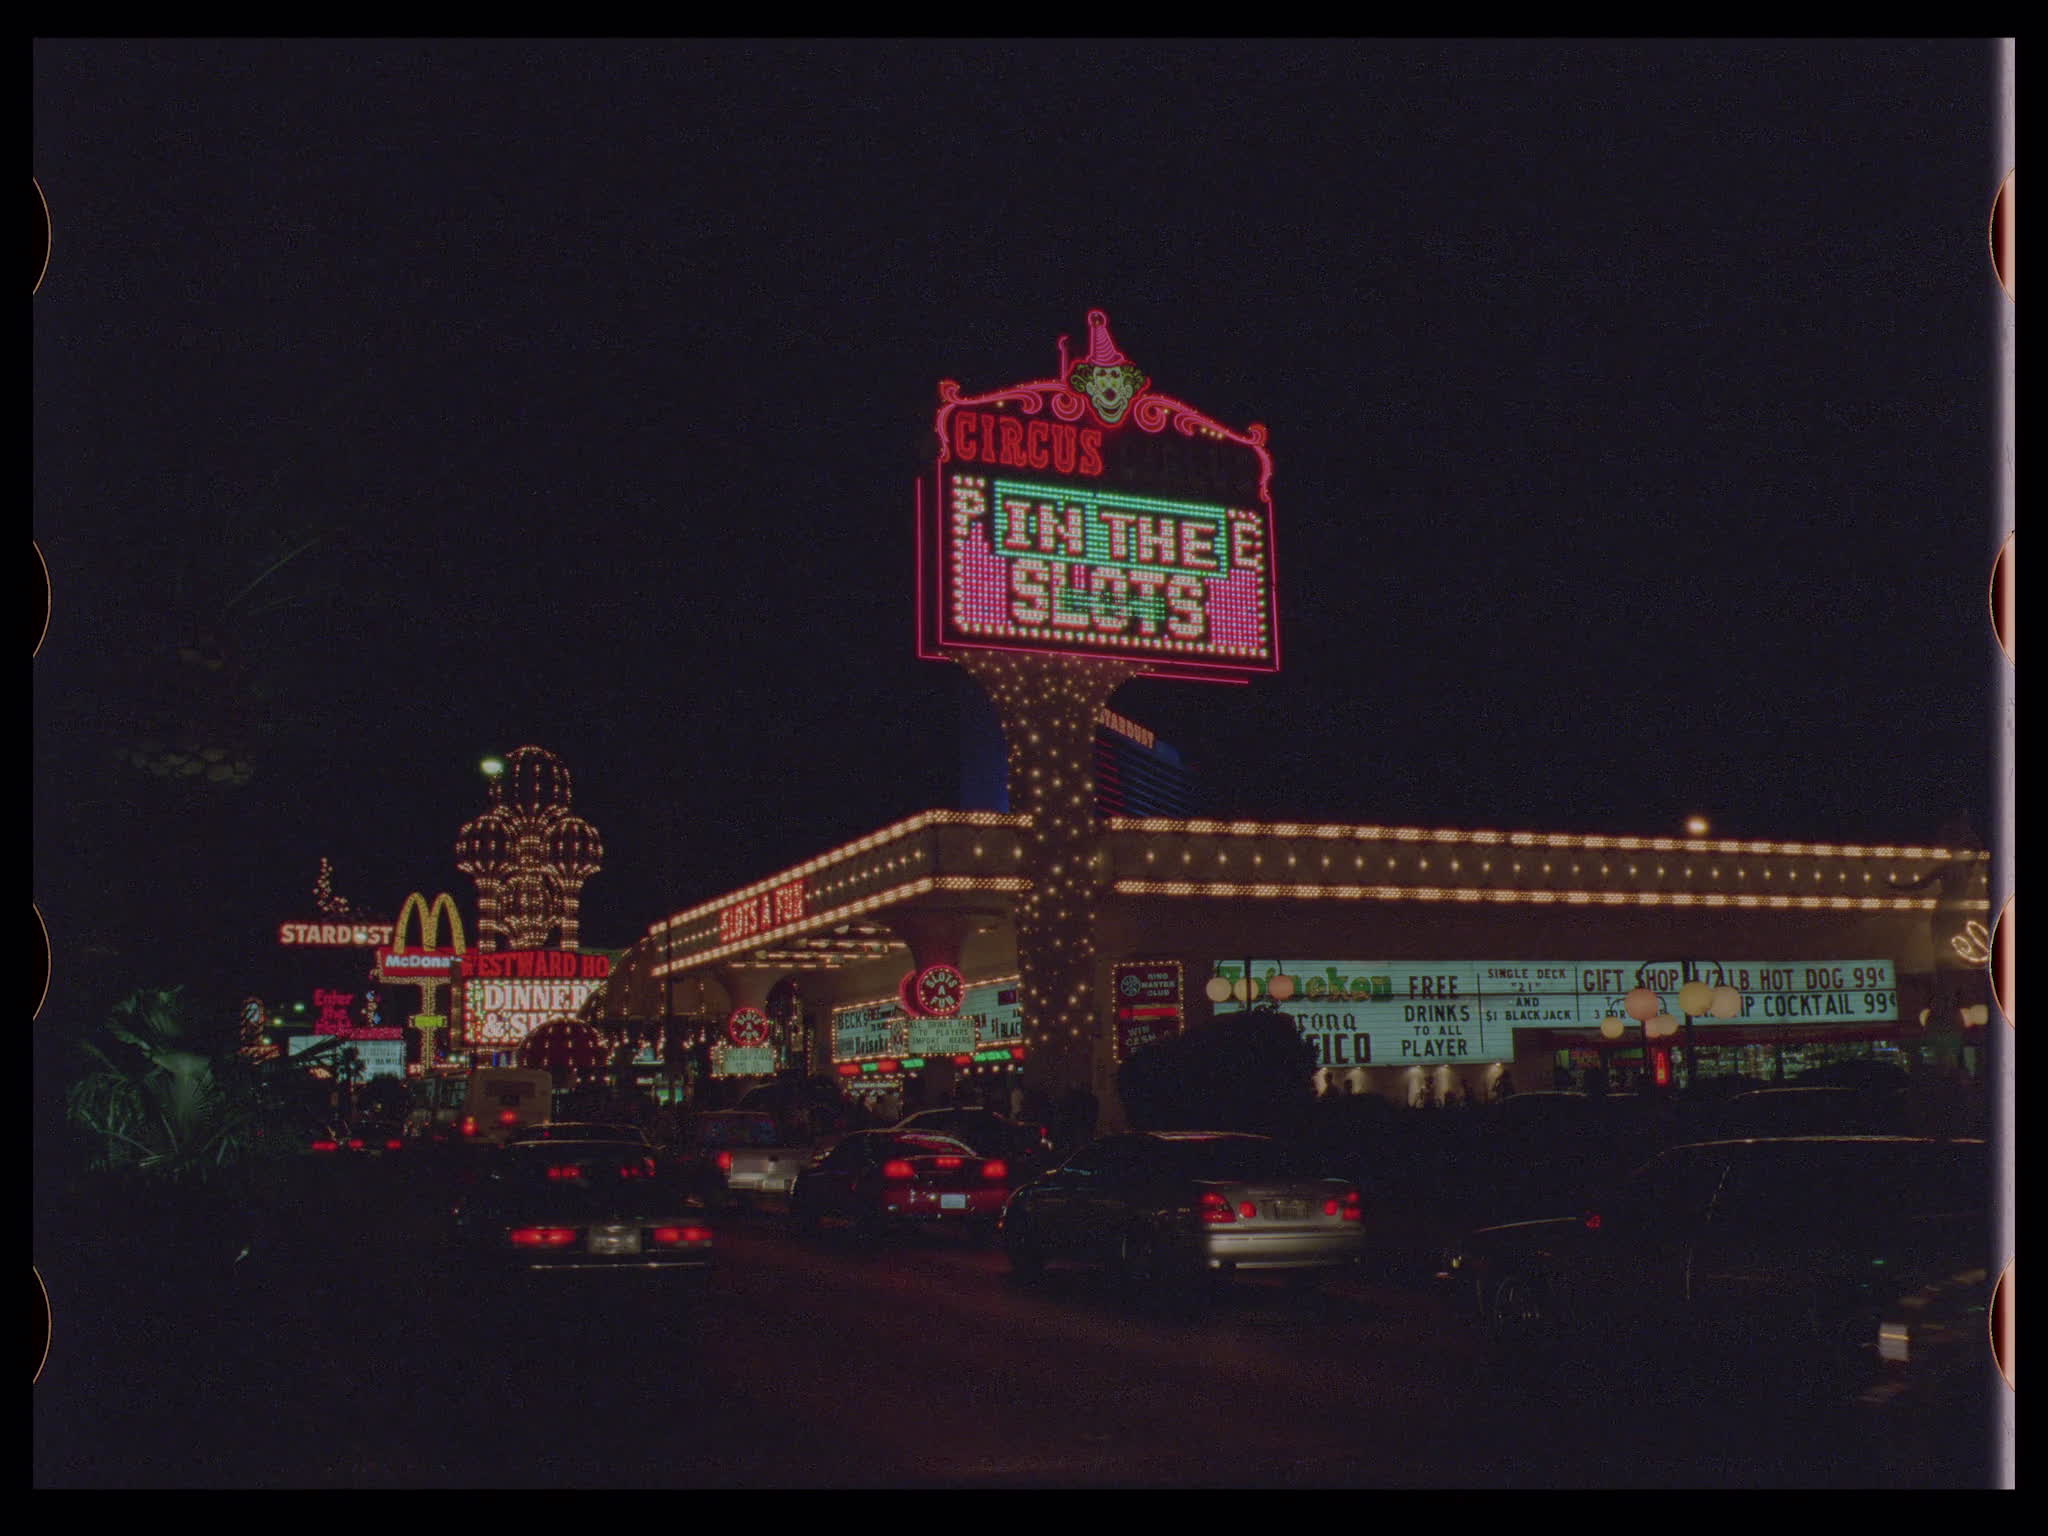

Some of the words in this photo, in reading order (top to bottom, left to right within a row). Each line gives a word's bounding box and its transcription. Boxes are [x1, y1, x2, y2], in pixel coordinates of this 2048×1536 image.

[954, 411, 1102, 475] CIRCUS
[1004, 500, 1083, 555] IN
[1101, 511, 1218, 569] THE
[1010, 557, 1205, 638] SLOTS
[719, 899, 759, 945] SLOTS
[774, 879, 804, 926] FUN
[280, 924, 393, 945] STARDUST
[384, 952, 463, 969] McDona
[462, 949, 578, 978] WESTWARD
[581, 953, 609, 978] HO
[925, 971, 960, 989] SLOTS
[1487, 968, 1529, 979] SINGLE
[1536, 968, 1568, 979] DECK
[1583, 968, 1624, 993] GIFT
[1636, 969, 1679, 992] SHOP
[1759, 968, 1794, 991] HOT
[1804, 967, 1845, 989] DOG
[483, 983, 590, 1011] DINNER
[937, 984, 947, 997] A
[1408, 974, 1458, 999] FREE
[929, 995, 955, 1009] FUN
[1516, 997, 1540, 1007] AND
[1763, 993, 1855, 1017] COCKTAIL
[1404, 1004, 1470, 1023] DRINKS
[1486, 1010, 1498, 1022] $1
[1413, 1024, 1430, 1036] TO
[1439, 1024, 1463, 1036] ALL
[1401, 1038, 1468, 1057] PLAYER
